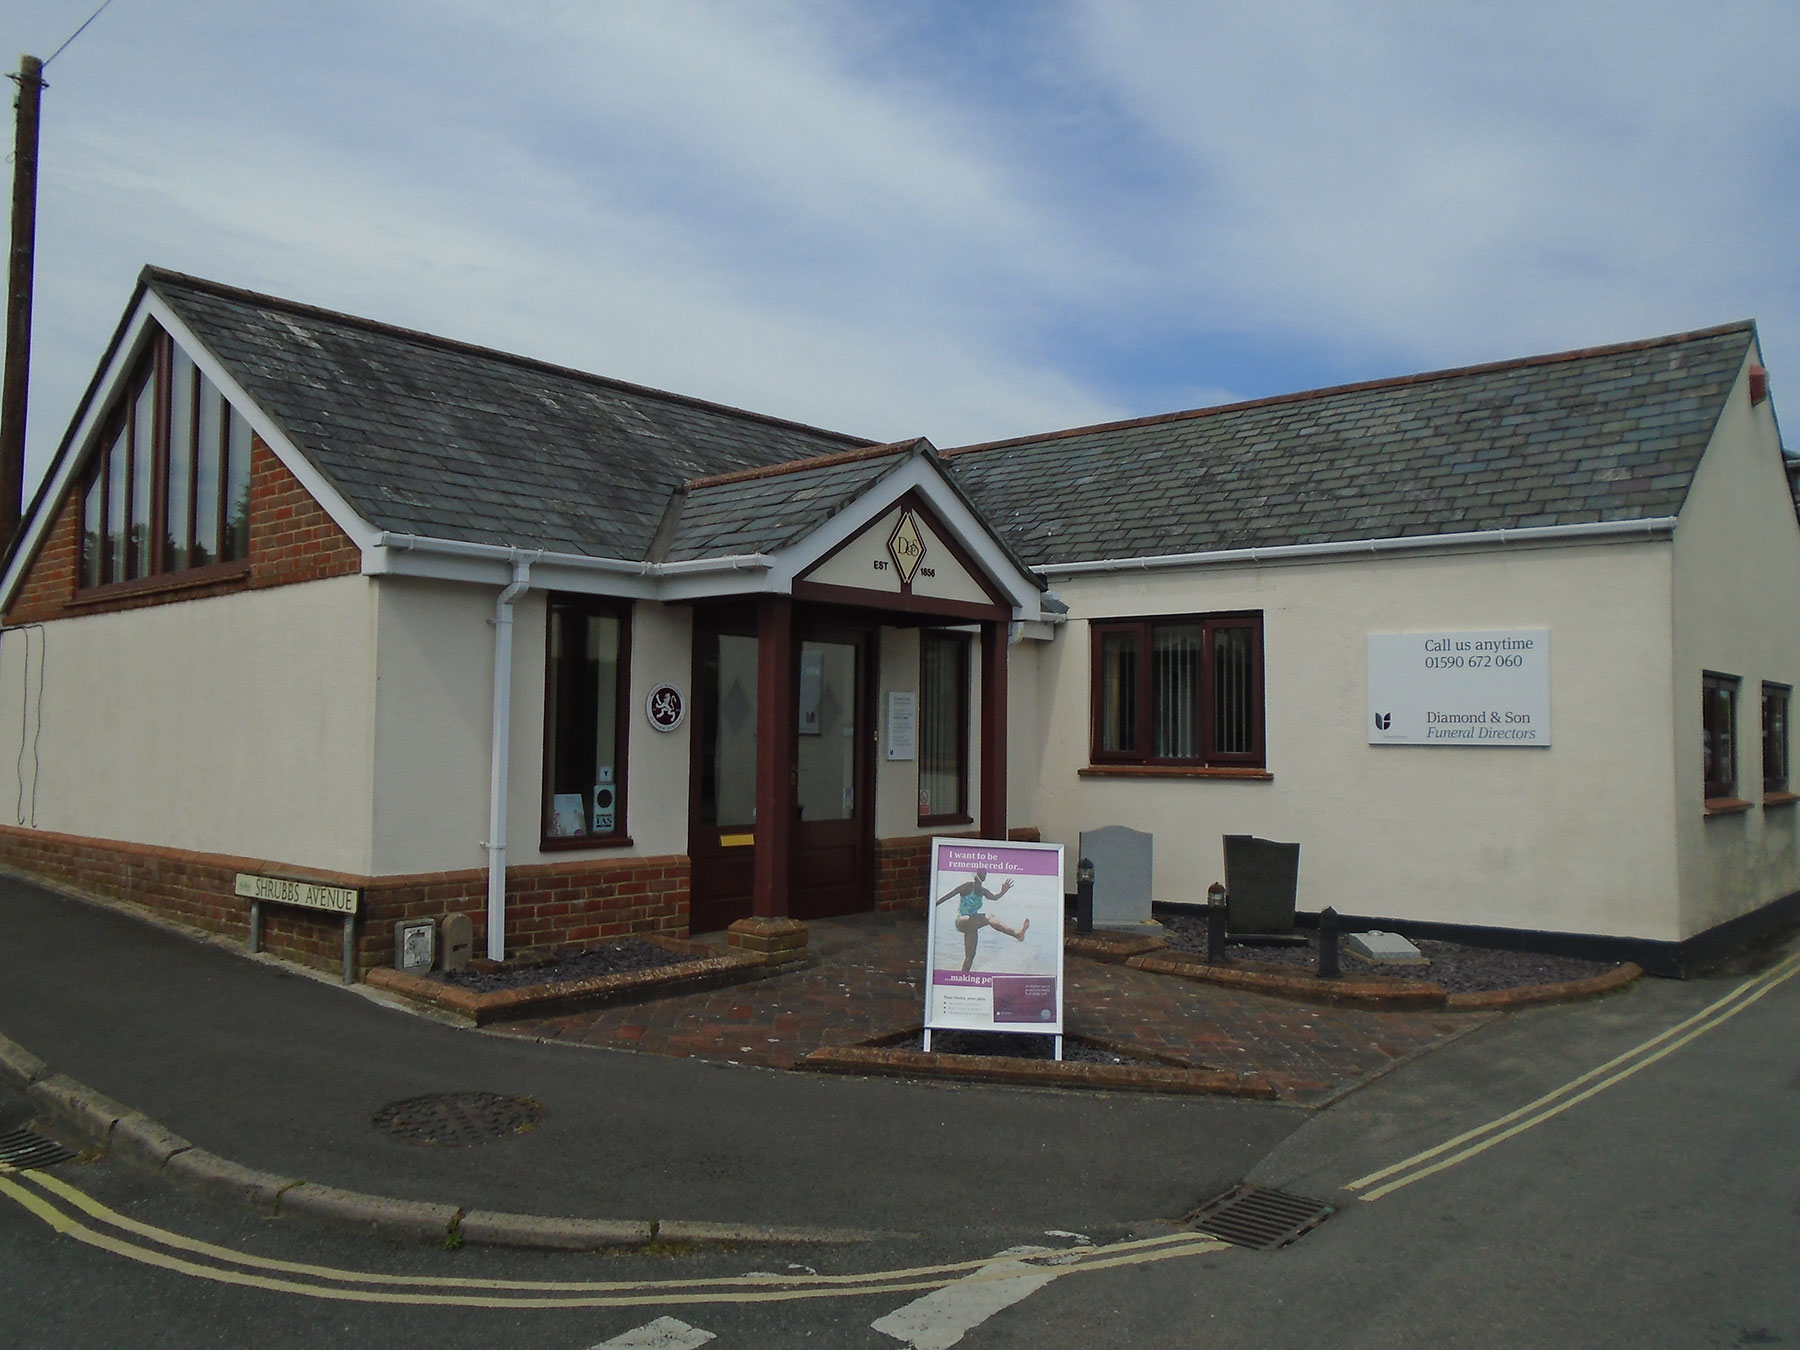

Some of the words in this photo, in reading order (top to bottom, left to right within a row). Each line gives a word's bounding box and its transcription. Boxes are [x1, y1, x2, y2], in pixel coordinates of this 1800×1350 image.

[874, 561, 888, 570] EST
[920, 568, 935, 577] 1856
[1425, 639, 1451, 651] Call
[1455, 639, 1472, 651] us
[1475, 638, 1534, 653] anytime
[1425, 656, 1464, 668] 01590
[1468, 656, 1491, 667] 672
[1495, 655, 1523, 667] 060
[1427, 711, 1486, 723] Diamond
[1490, 712, 1502, 723] &
[1504, 712, 1530, 723] Son
[1427, 727, 1474, 738] Funeral
[1478, 727, 1536, 739] Directors
[954, 852, 975, 860] want
[977, 852, 986, 860] to
[949, 861, 1003, 870] remembered
[1005, 863, 1024, 871] for...
[256, 879, 300, 902] SHRUBBS
[305, 888, 351, 910] AVENUE
[944, 974, 981, 984] ...making
